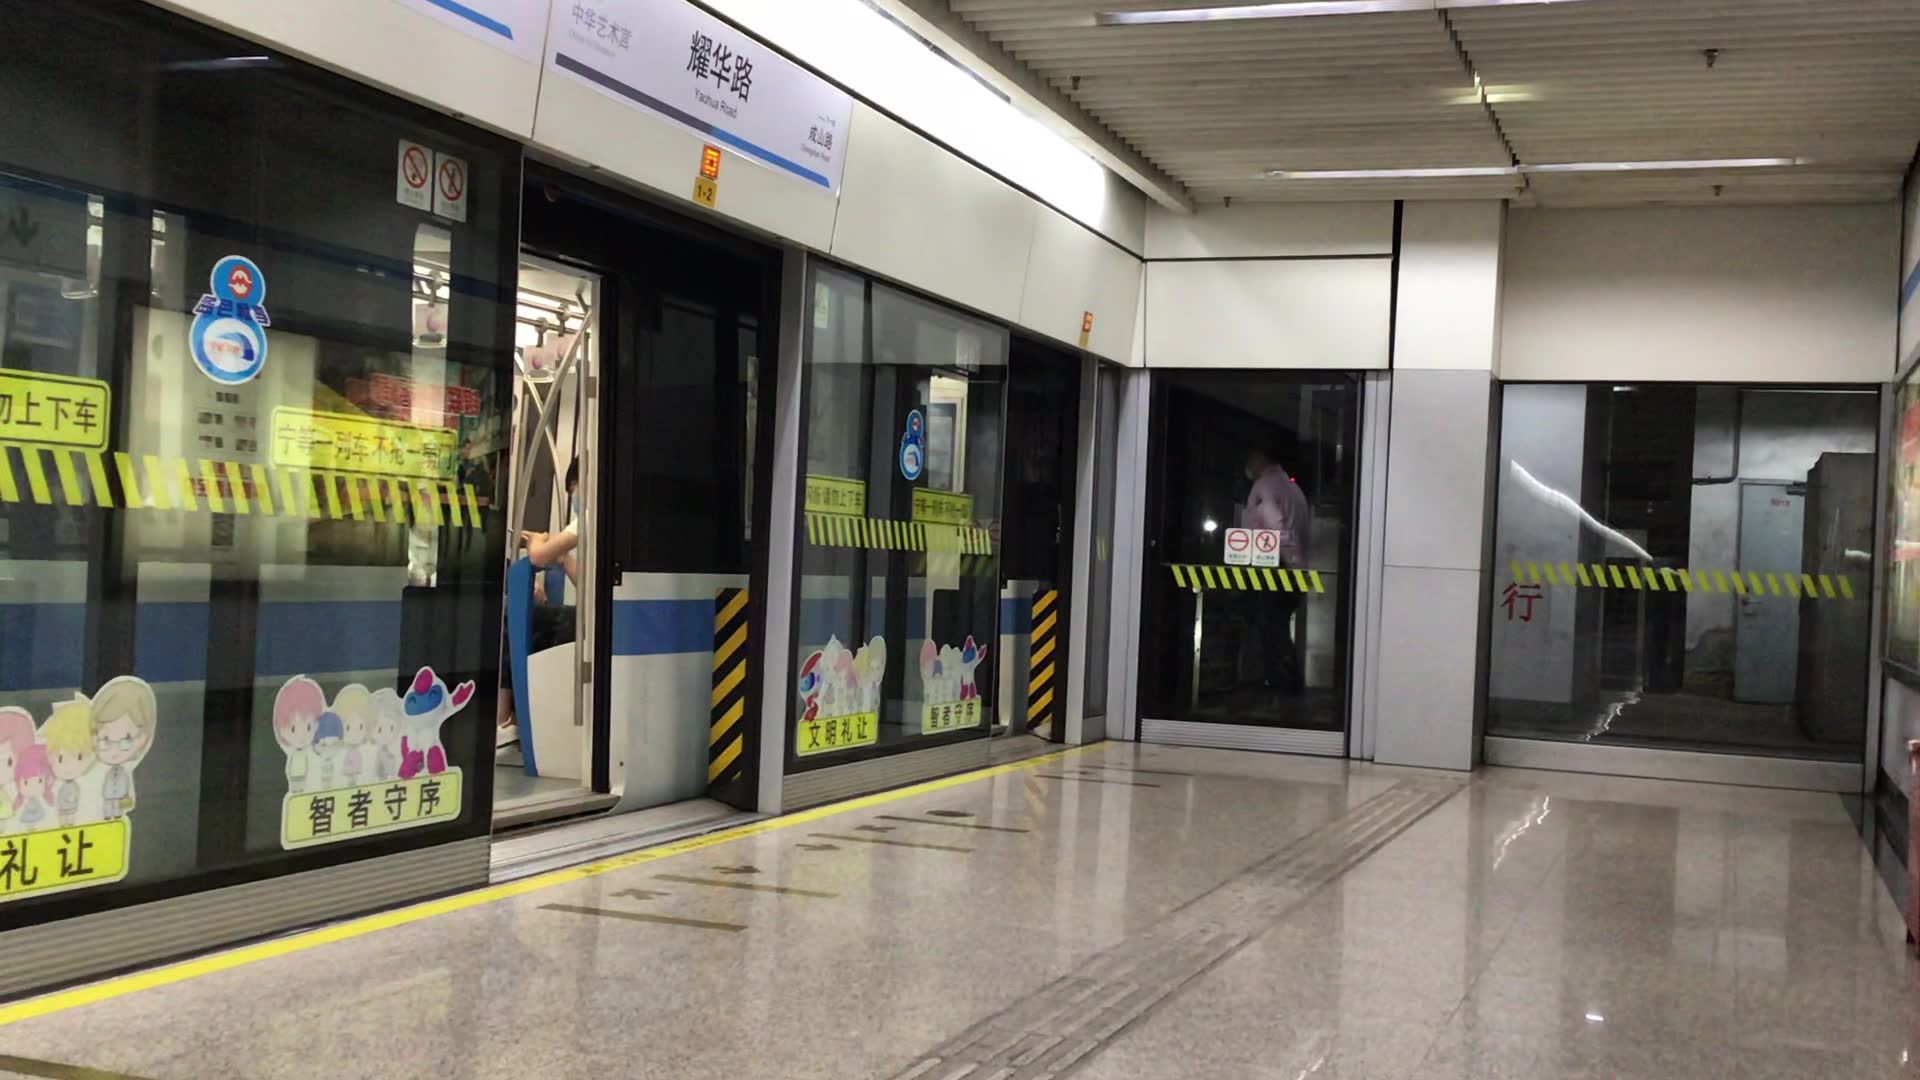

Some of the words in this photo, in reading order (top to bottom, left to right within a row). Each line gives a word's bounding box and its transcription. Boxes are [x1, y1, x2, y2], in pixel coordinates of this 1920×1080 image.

[686, 30, 753, 103] 耀华路
[720, 100, 738, 119] Road
[808, 125, 832, 150] 成山路
[1500, 582, 1543, 622] 行
[808, 714, 868, 749] 文明礼让
[309, 779, 441, 836] 智者守序
[0, 829, 94, 890] 礼让
